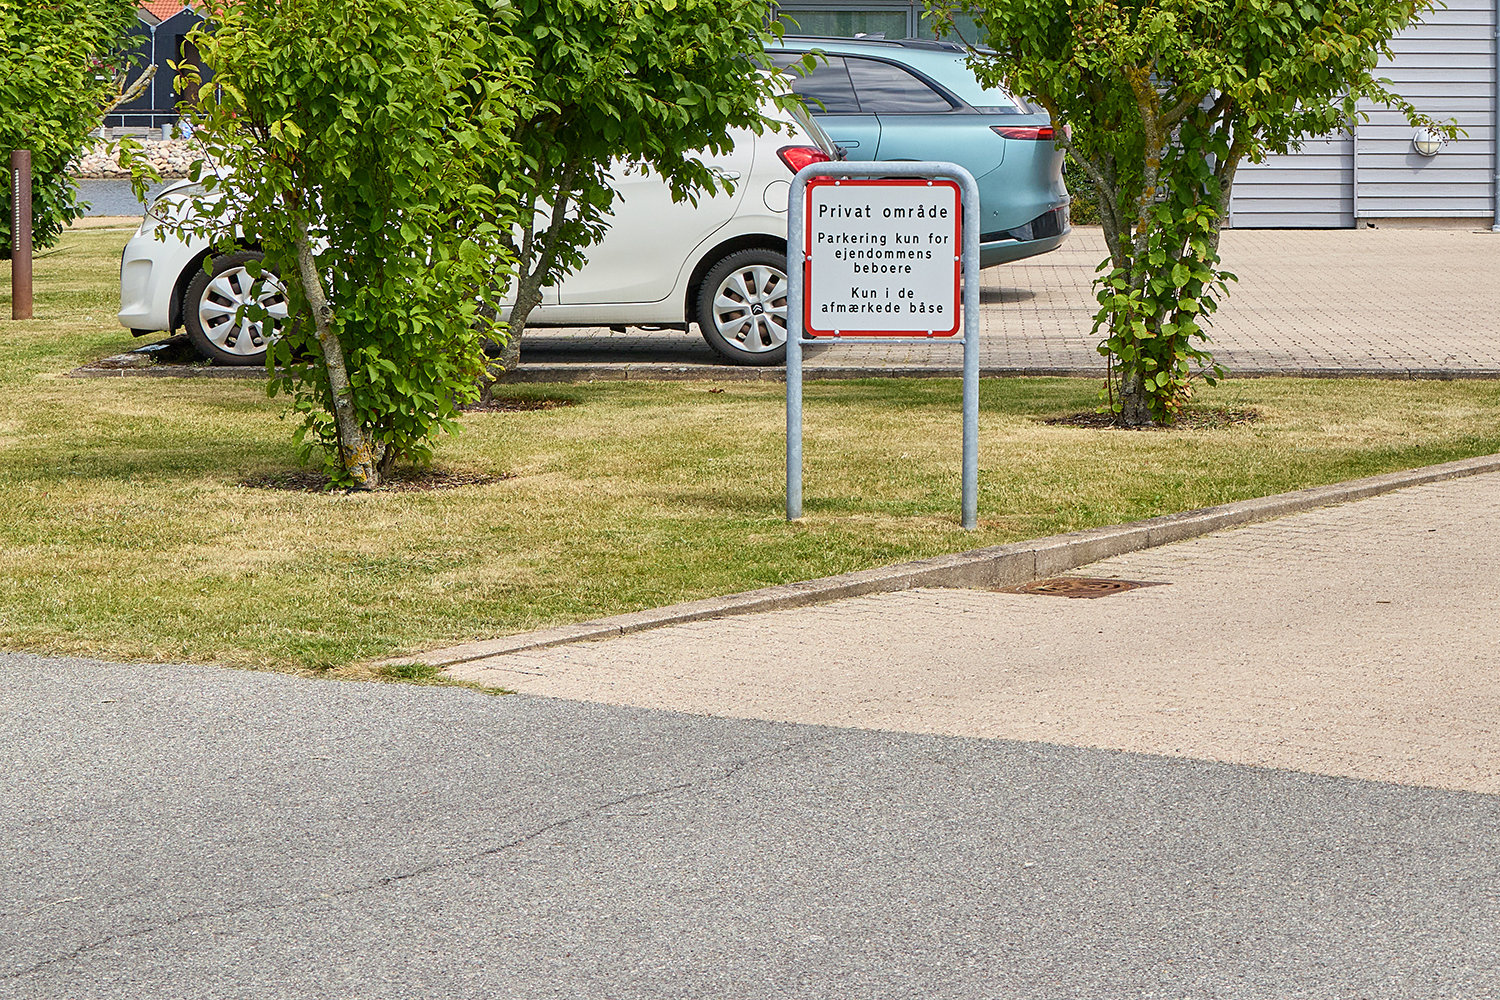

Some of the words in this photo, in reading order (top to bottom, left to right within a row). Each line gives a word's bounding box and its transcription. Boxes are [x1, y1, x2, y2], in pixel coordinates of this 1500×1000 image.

[819, 204, 871, 218] Privat
[883, 204, 948, 218] område
[817, 233, 887, 246] Parkering
[895, 233, 920, 244] kun
[928, 233, 949, 244] for
[835, 248, 932, 260] ejendommens
[854, 263, 912, 274] beboere
[851, 287, 877, 298] Kun
[885, 288, 889, 298] i
[898, 288, 914, 299] de
[821, 302, 900, 313] afmærkede
[910, 302, 943, 313] båse
